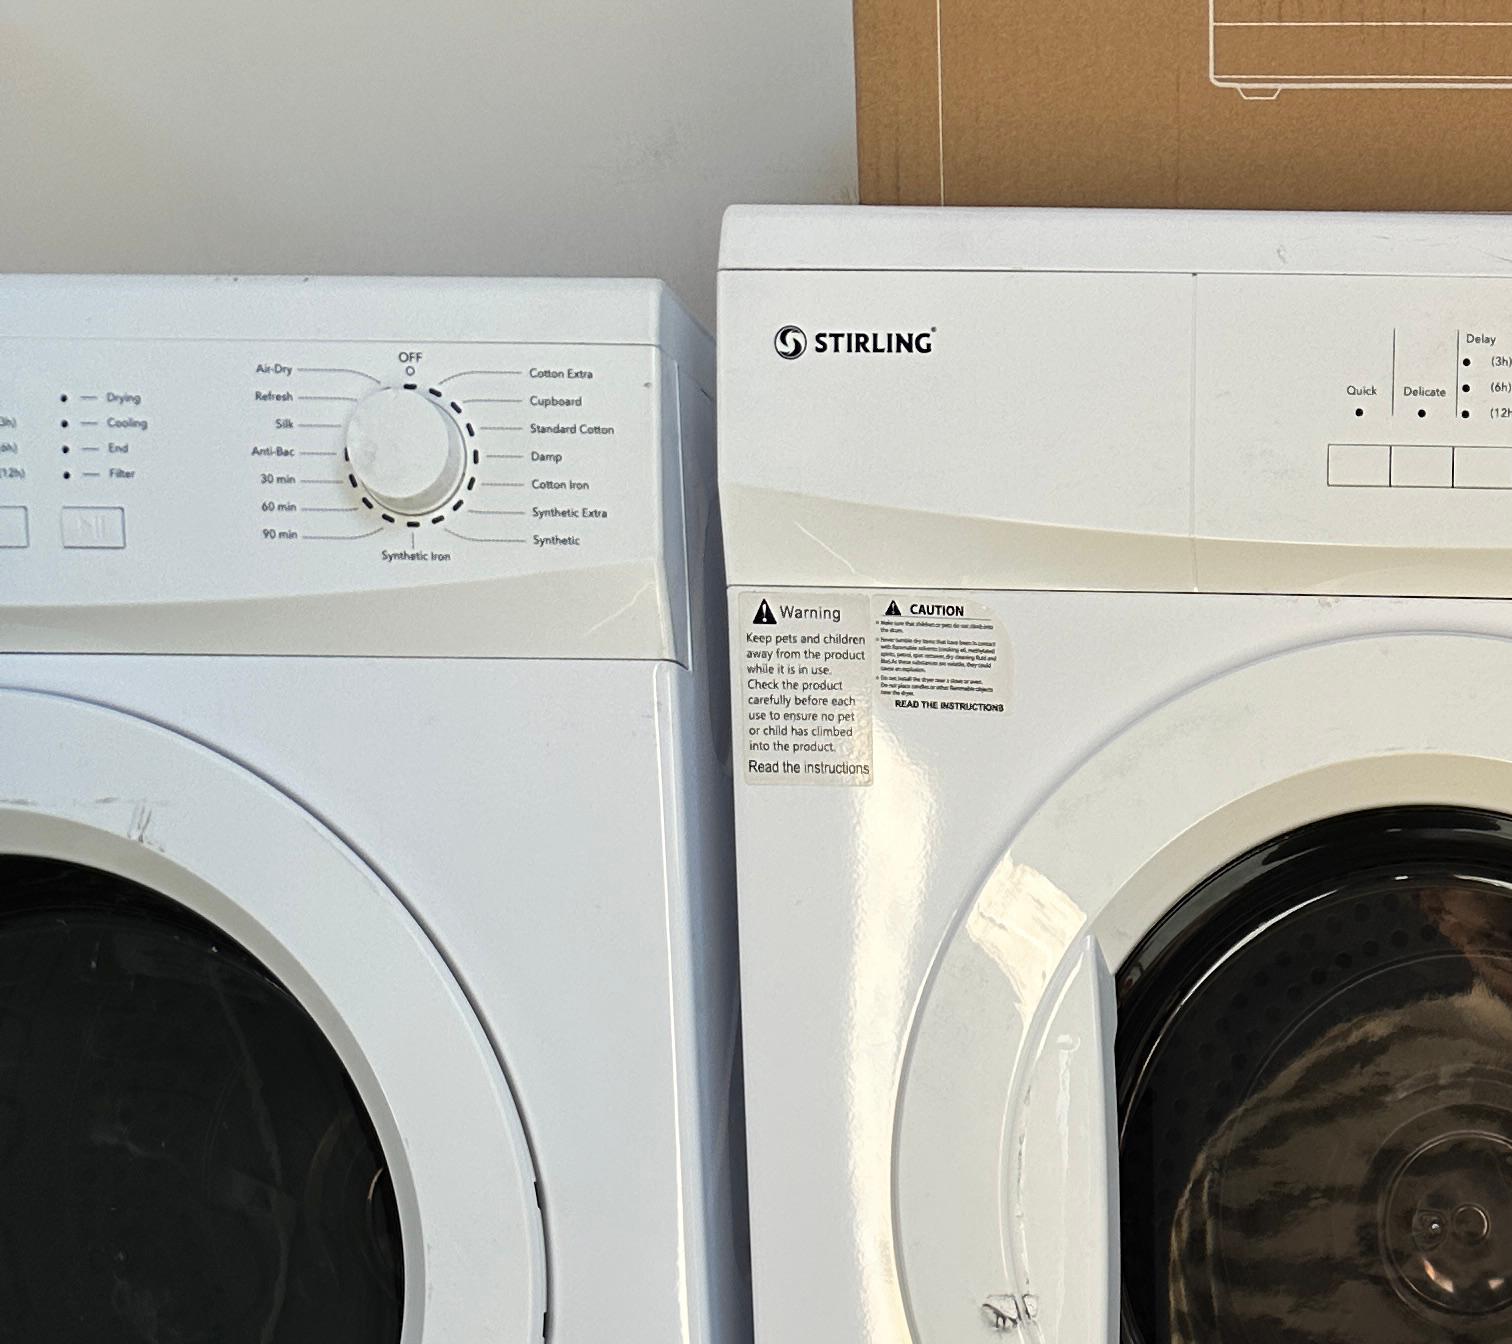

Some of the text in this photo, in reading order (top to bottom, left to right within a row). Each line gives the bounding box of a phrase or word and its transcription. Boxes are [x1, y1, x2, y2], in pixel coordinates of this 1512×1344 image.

[815, 332, 932, 354] STIRLING
[1467, 334, 1496, 346] Delay
[399, 352, 422, 363] OFF
[1492, 356, 1512, 367] (3h)
[1347, 385, 1376, 395] Quick
[1404, 386, 1446, 397] Delicate
[1491, 382, 1511, 392] (6h)
[530, 396, 582, 408] Cupboard
[107, 417, 148, 431] Cooling
[531, 451, 562, 464] Damp
[262, 502, 296, 511] 60 min
[780, 606, 840, 622] Warning
[910, 604, 963, 616] CAUTION
[747, 632, 865, 645] Keep pets and children
[747, 648, 865, 661] away from the product
[747, 664, 774, 674] while
[778, 665, 784, 674] it
[788, 665, 795, 674] is
[799, 666, 808, 674] in
[748, 679, 842, 692] Check the product
[748, 694, 855, 708] carefully before each
[895, 700, 919, 708] READ
[921, 701, 938, 709] THE
[770, 711, 780, 720] to
[784, 713, 817, 721] ensure
[838, 713, 854, 724] pet
[763, 726, 787, 735] child
[792, 726, 808, 736] has
[812, 726, 852, 736] climbed
[750, 742, 769, 751] into
[773, 741, 789, 751] the
[749, 760, 869, 774] Read the instructions
